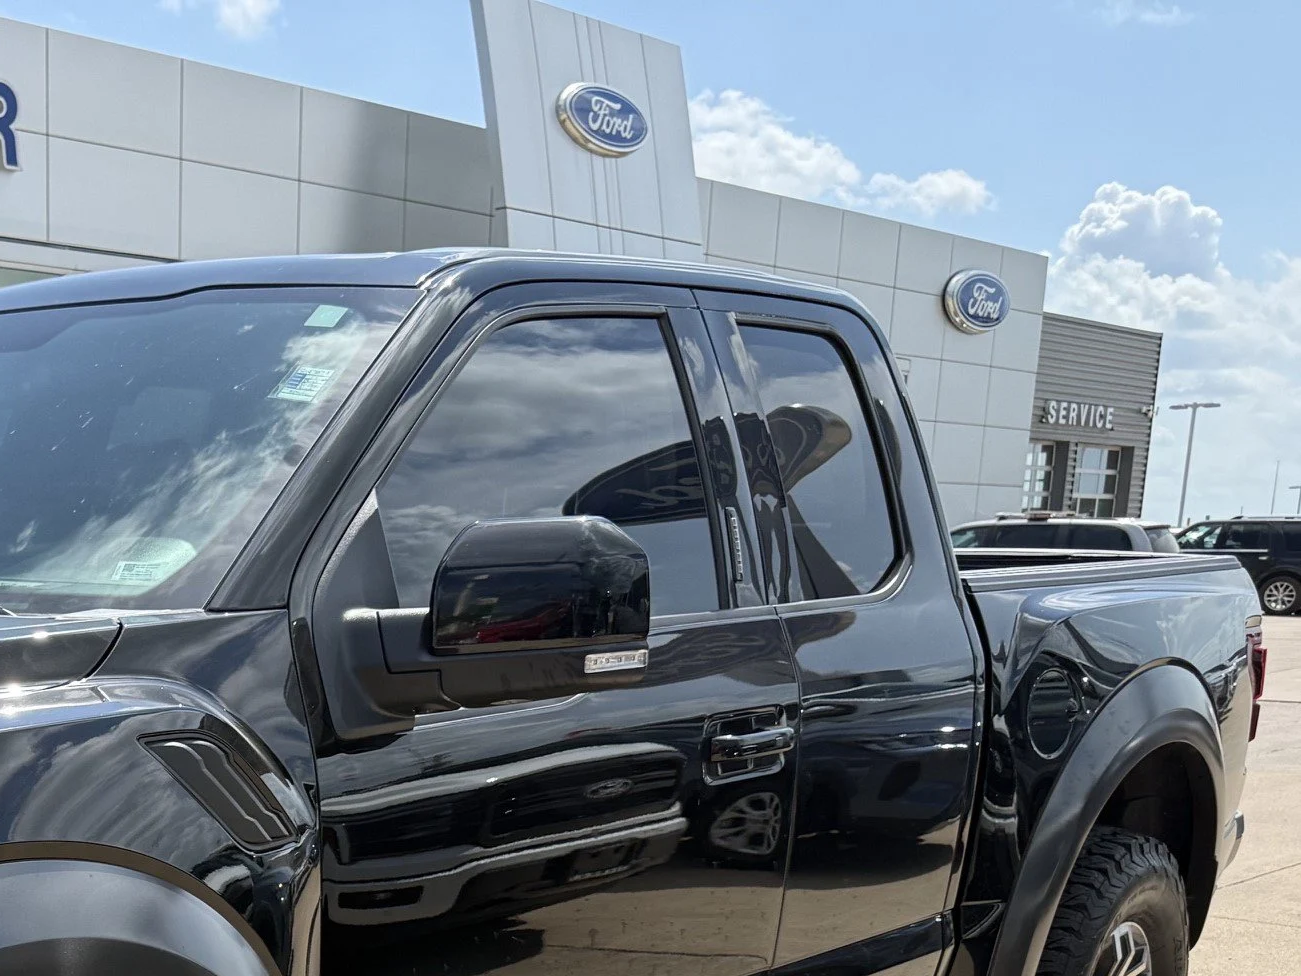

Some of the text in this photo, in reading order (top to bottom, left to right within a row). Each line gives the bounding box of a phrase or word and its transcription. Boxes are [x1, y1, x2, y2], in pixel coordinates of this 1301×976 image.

[588, 95, 634, 140] Ford
[967, 282, 1003, 320] Ford
[1047, 400, 1115, 429] SERVICE
